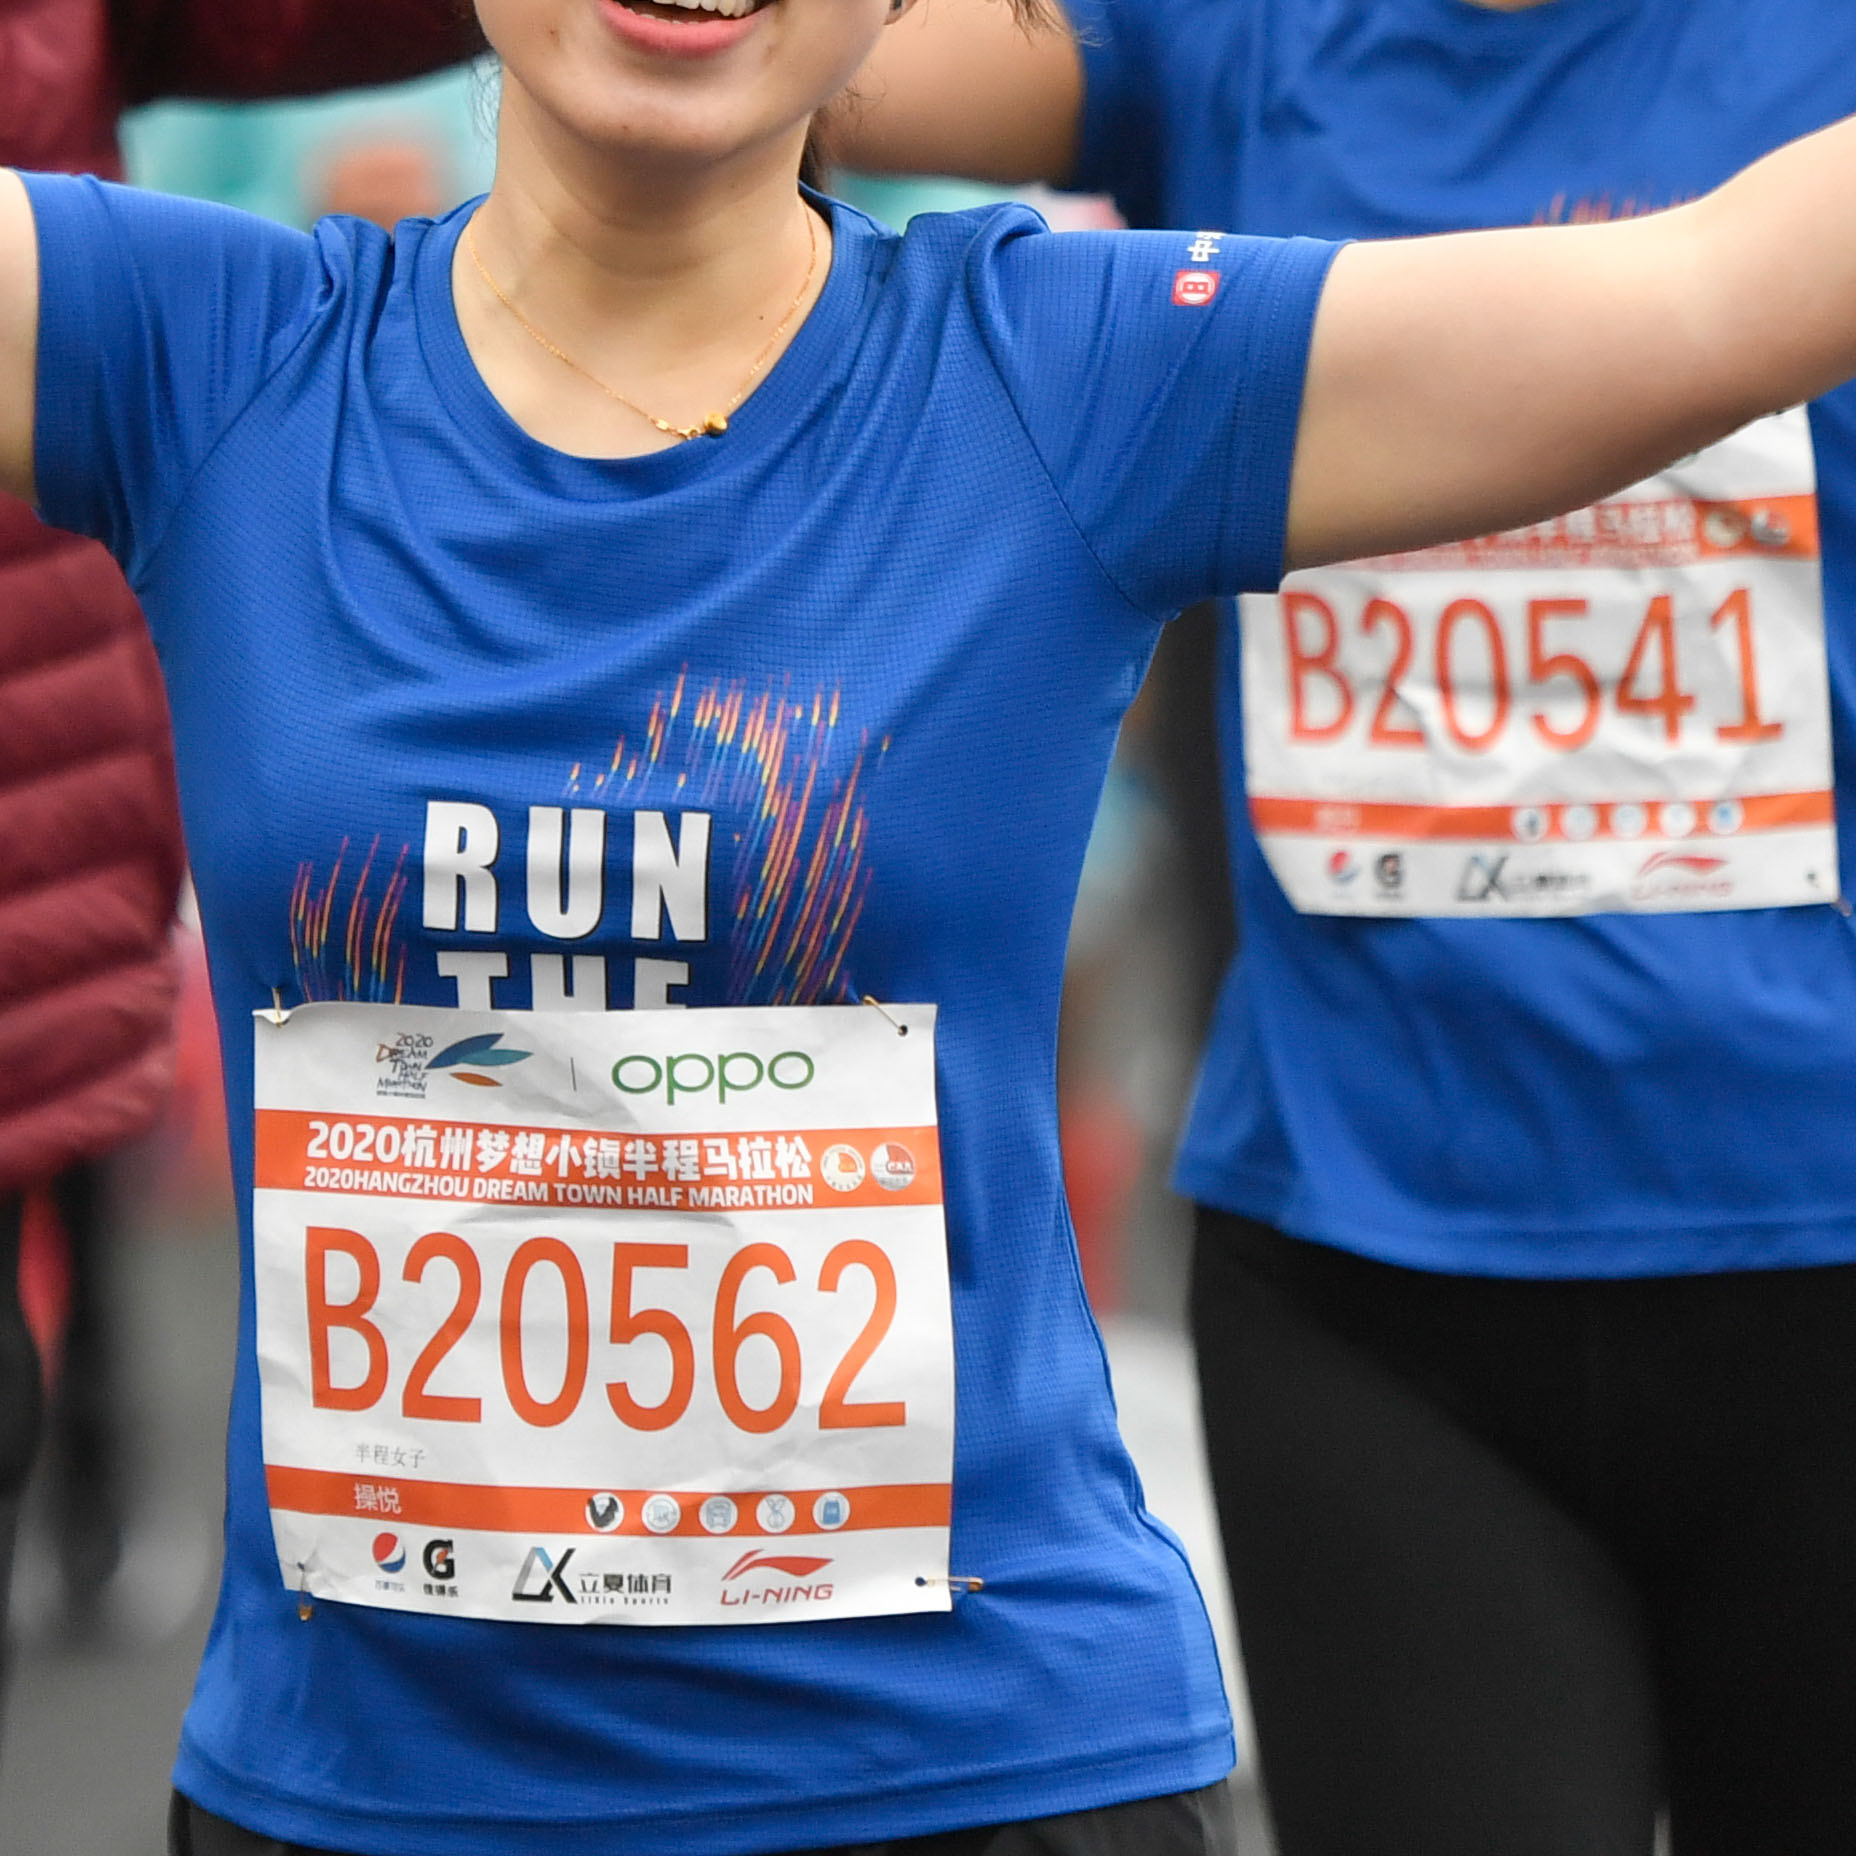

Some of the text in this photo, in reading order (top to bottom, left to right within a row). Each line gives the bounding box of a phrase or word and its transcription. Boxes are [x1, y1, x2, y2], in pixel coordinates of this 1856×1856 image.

[1281, 587, 1785, 752] B20541
[423, 801, 711, 942] RUN
[304, 1165, 813, 1207] 2020HANGZHOU DREAM TOWN HALF MARATHON
[305, 1225, 907, 1434] B20562
[721, 1583, 834, 1606] LI-NING
